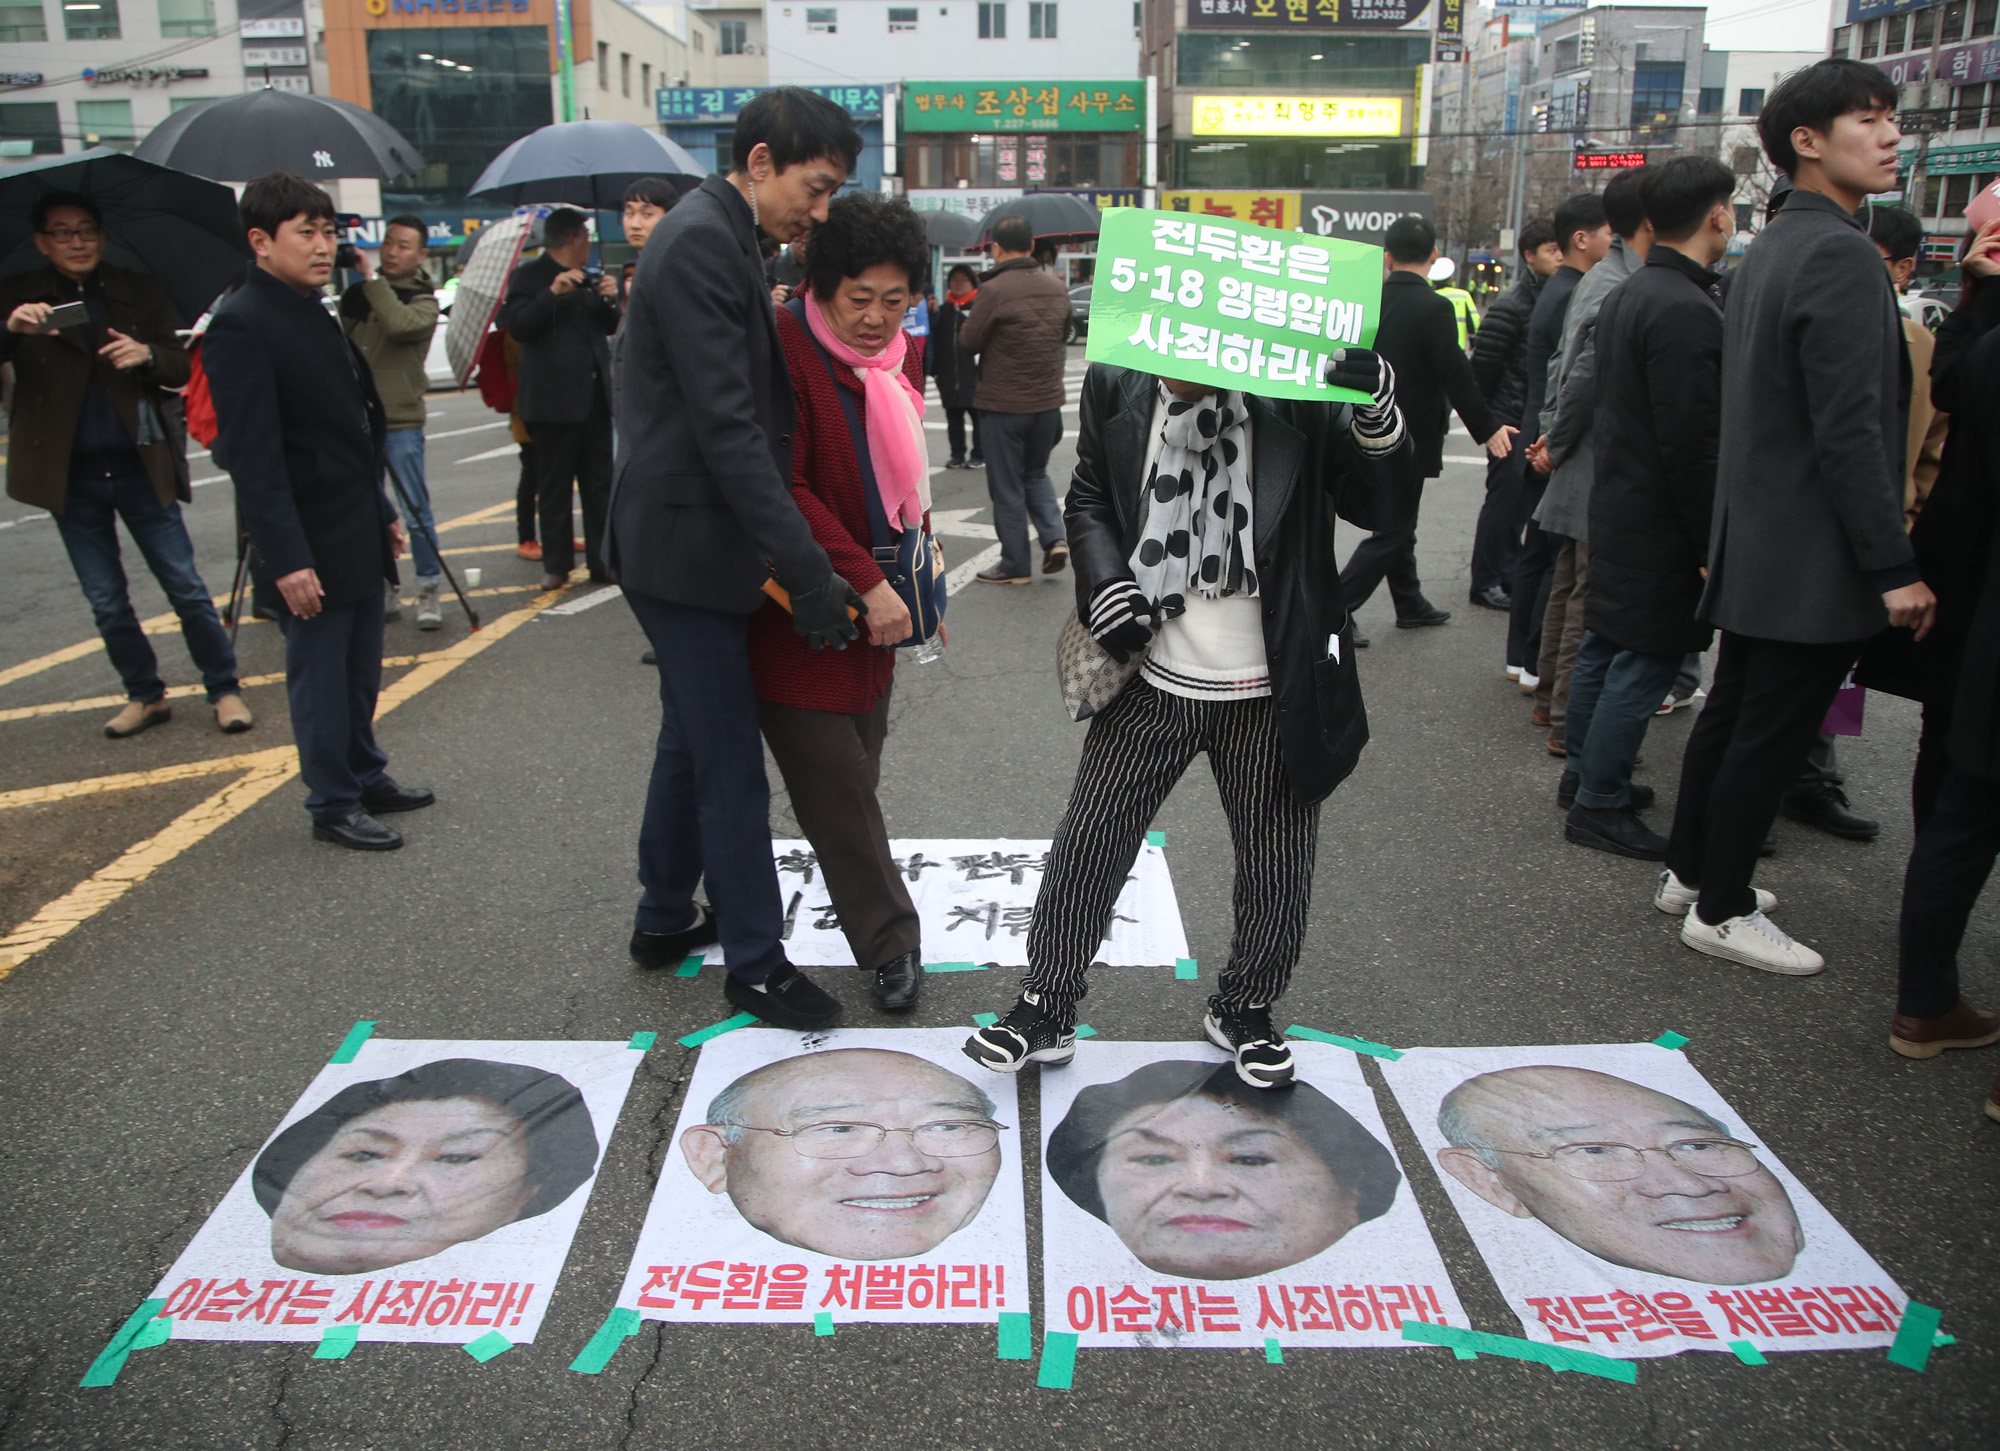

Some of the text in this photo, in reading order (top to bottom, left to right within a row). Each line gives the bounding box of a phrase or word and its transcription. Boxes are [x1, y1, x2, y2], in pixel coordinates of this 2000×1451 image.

[914, 86, 1137, 117] 법무사 조상섭 사무소
[1274, 101, 1338, 122] 최영주
[1151, 218, 1331, 284] 전두환은
[1110, 257, 1364, 345] 5·18 영령앞에
[1128, 312, 1330, 389] 사죄하라!
[157, 1277, 535, 1328] 이순자는 사죄하라!
[637, 1260, 1005, 1311] 전두환을 처벌하라!
[1066, 1283, 1449, 1334] 이순자는 사죄하라!
[1525, 1289, 1718, 1344] 전두환을
